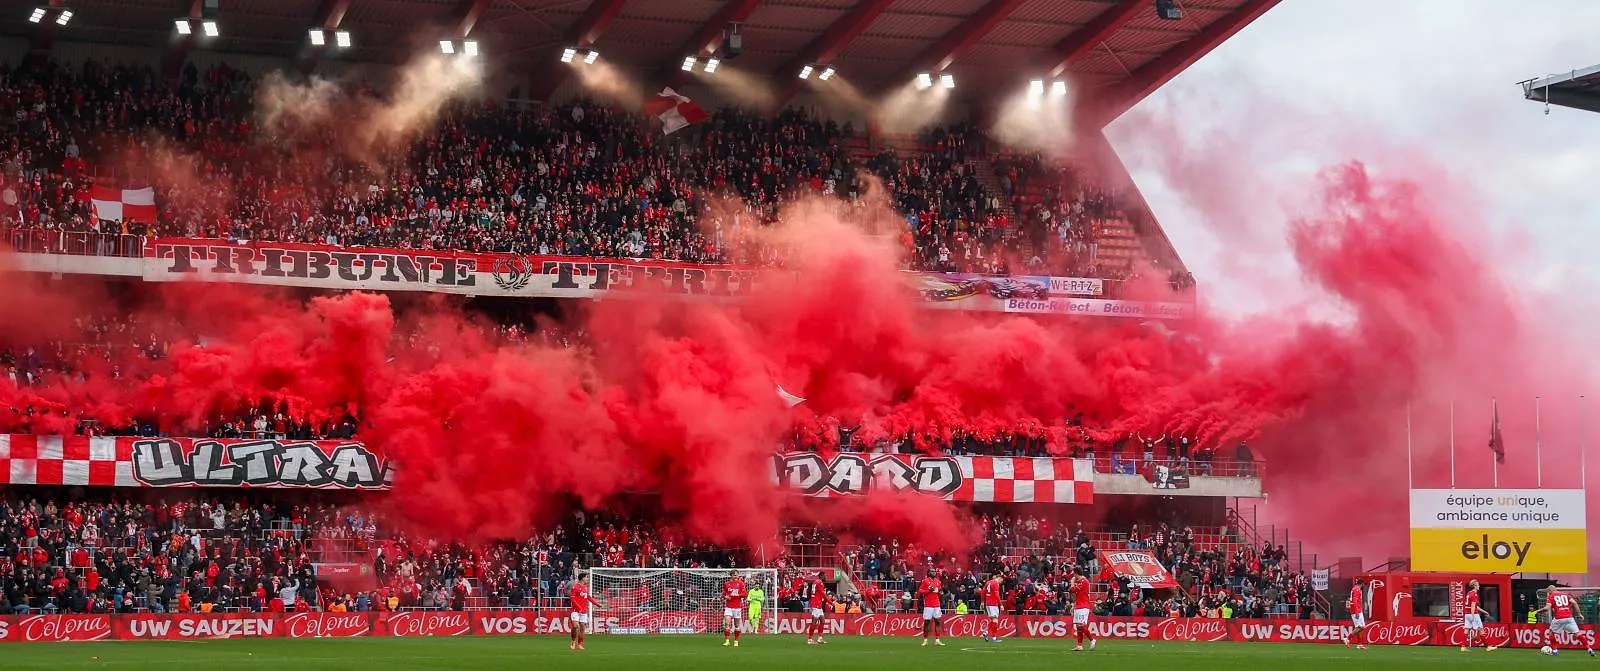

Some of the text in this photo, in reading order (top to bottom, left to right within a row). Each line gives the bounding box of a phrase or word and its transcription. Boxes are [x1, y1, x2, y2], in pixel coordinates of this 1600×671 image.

[155, 243, 478, 286] TRIBUNE
[132, 440, 392, 487] ULTRA
[1446, 494, 1548, 508] équipe unique,
[1437, 510, 1560, 523] ambiance unique
[1126, 553, 1150, 563] BOYS
[1461, 533, 1532, 566] eloy
[1455, 581, 1464, 601] VALK
[1553, 594, 1569, 607] 80
[19, 615, 111, 641] Colona
[130, 618, 274, 637] UW SAUZEN
[284, 612, 370, 638] Colona
[388, 612, 471, 637] Colona
[481, 616, 527, 634] VOS
[854, 614, 924, 637] Colona
[944, 615, 1017, 638] Coloa
[1026, 620, 1150, 638] VOS AUCES
[1157, 618, 1228, 641] Colona
[1241, 623, 1274, 640] UW
[1363, 621, 1430, 646] Colona
[1515, 628, 1541, 645] VOS
